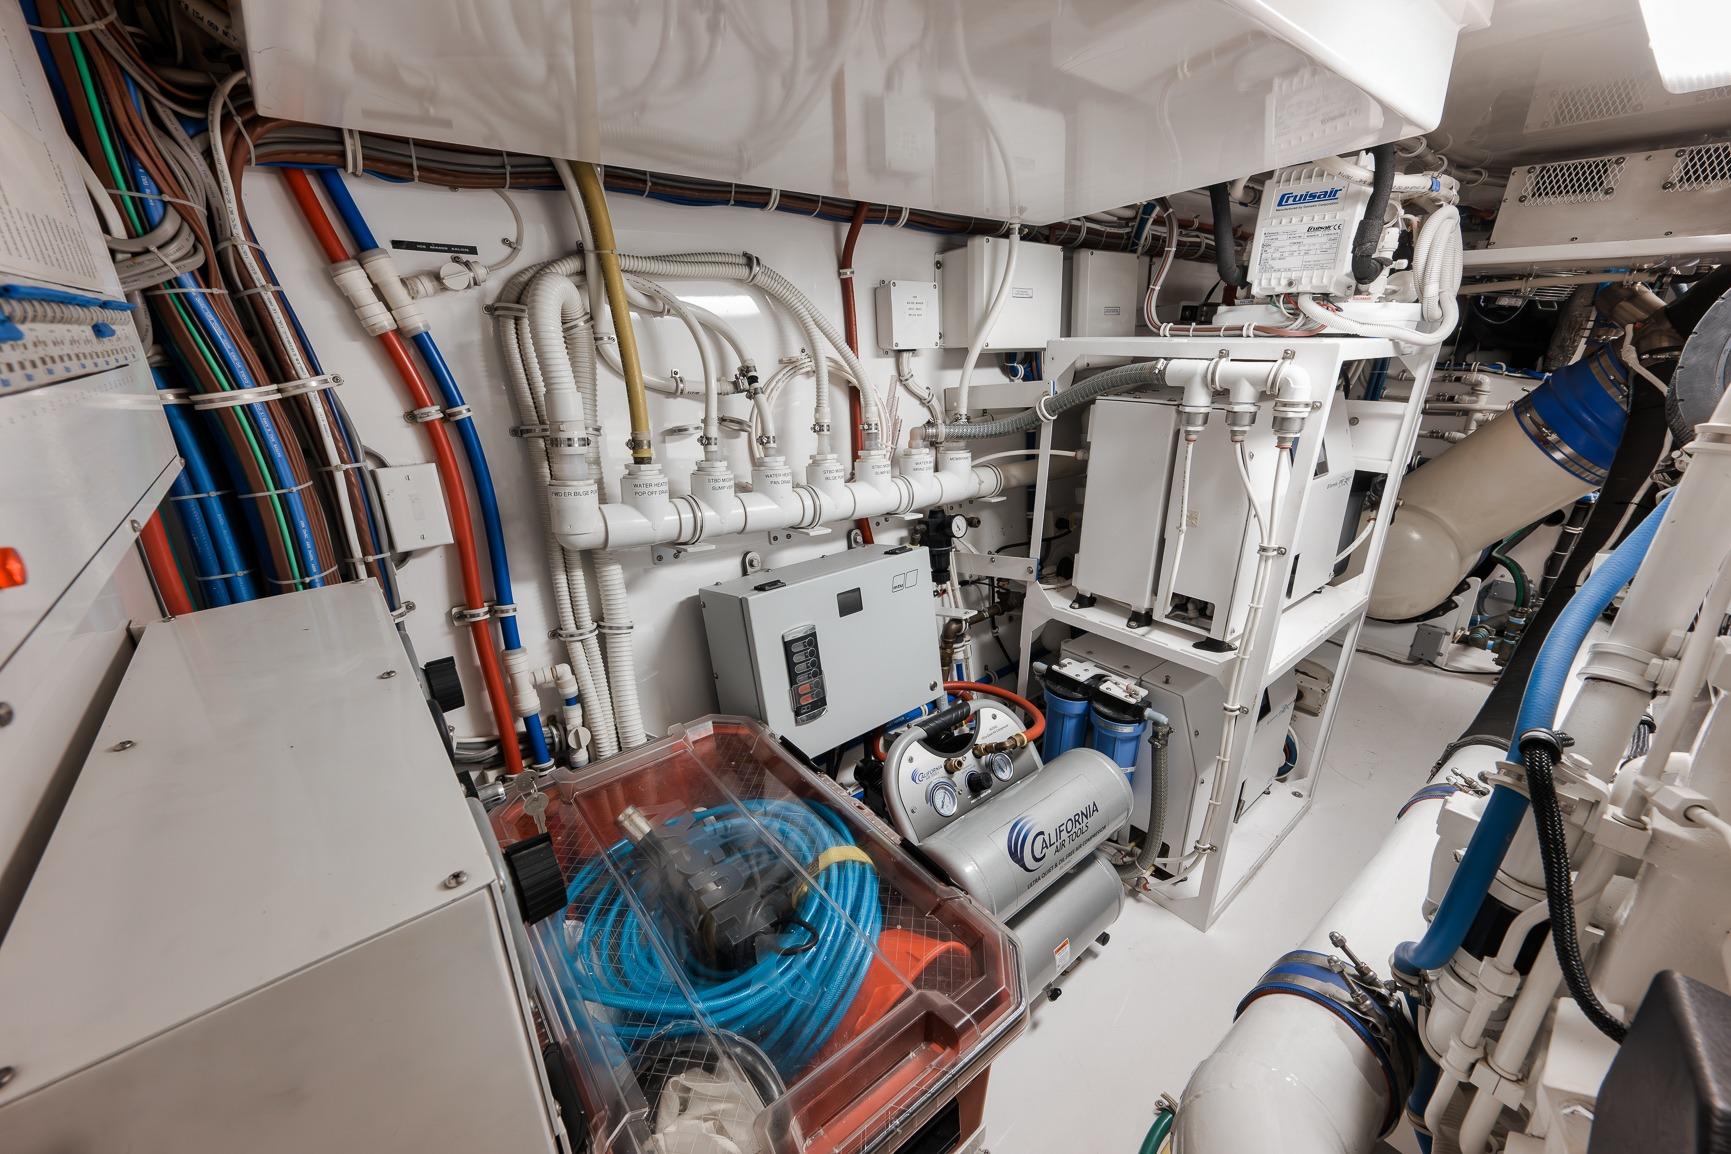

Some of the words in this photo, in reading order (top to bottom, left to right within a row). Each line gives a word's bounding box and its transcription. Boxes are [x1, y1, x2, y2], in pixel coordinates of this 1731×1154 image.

[1276, 188, 1342, 207] Cruisair
[1031, 801, 1099, 863] CALIFORNIA
[1054, 840, 1066, 856] AIR
[1067, 822, 1089, 845] TOOLS
[1027, 876, 1041, 890] ULTRA
[1041, 866, 1054, 879] QUIET
